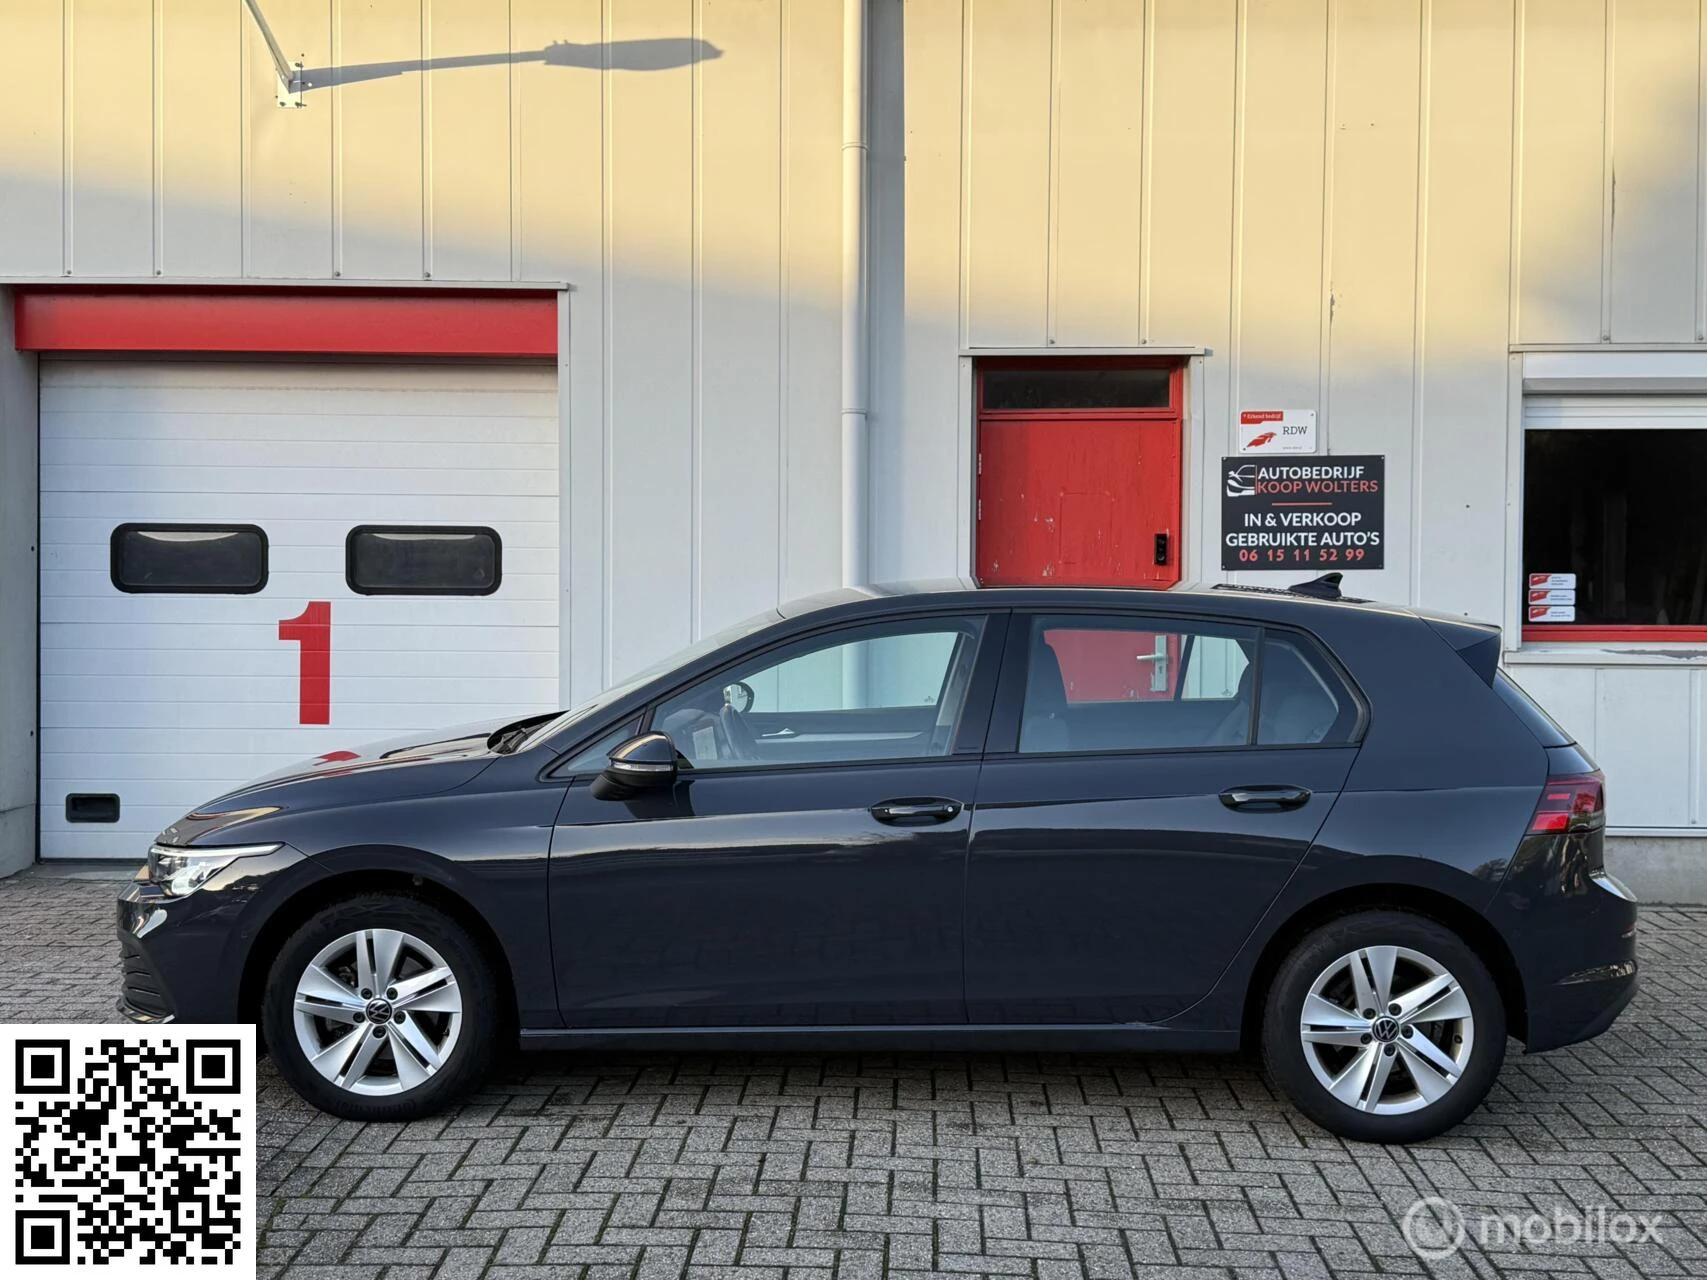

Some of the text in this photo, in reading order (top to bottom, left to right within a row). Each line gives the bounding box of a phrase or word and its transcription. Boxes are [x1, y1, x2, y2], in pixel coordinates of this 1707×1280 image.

[1282, 426, 1308, 435] RDW
[1258, 466, 1365, 479] AUTOBEDRIJF
[1257, 480, 1378, 494] KOOP WOLTERS
[1244, 512, 1362, 527] IN & VERKOOP
[1225, 531, 1380, 547] GEBRUIKTE AUTO'S
[1239, 549, 1365, 562] 06 15 11 52 99
[278, 601, 331, 725] 1
